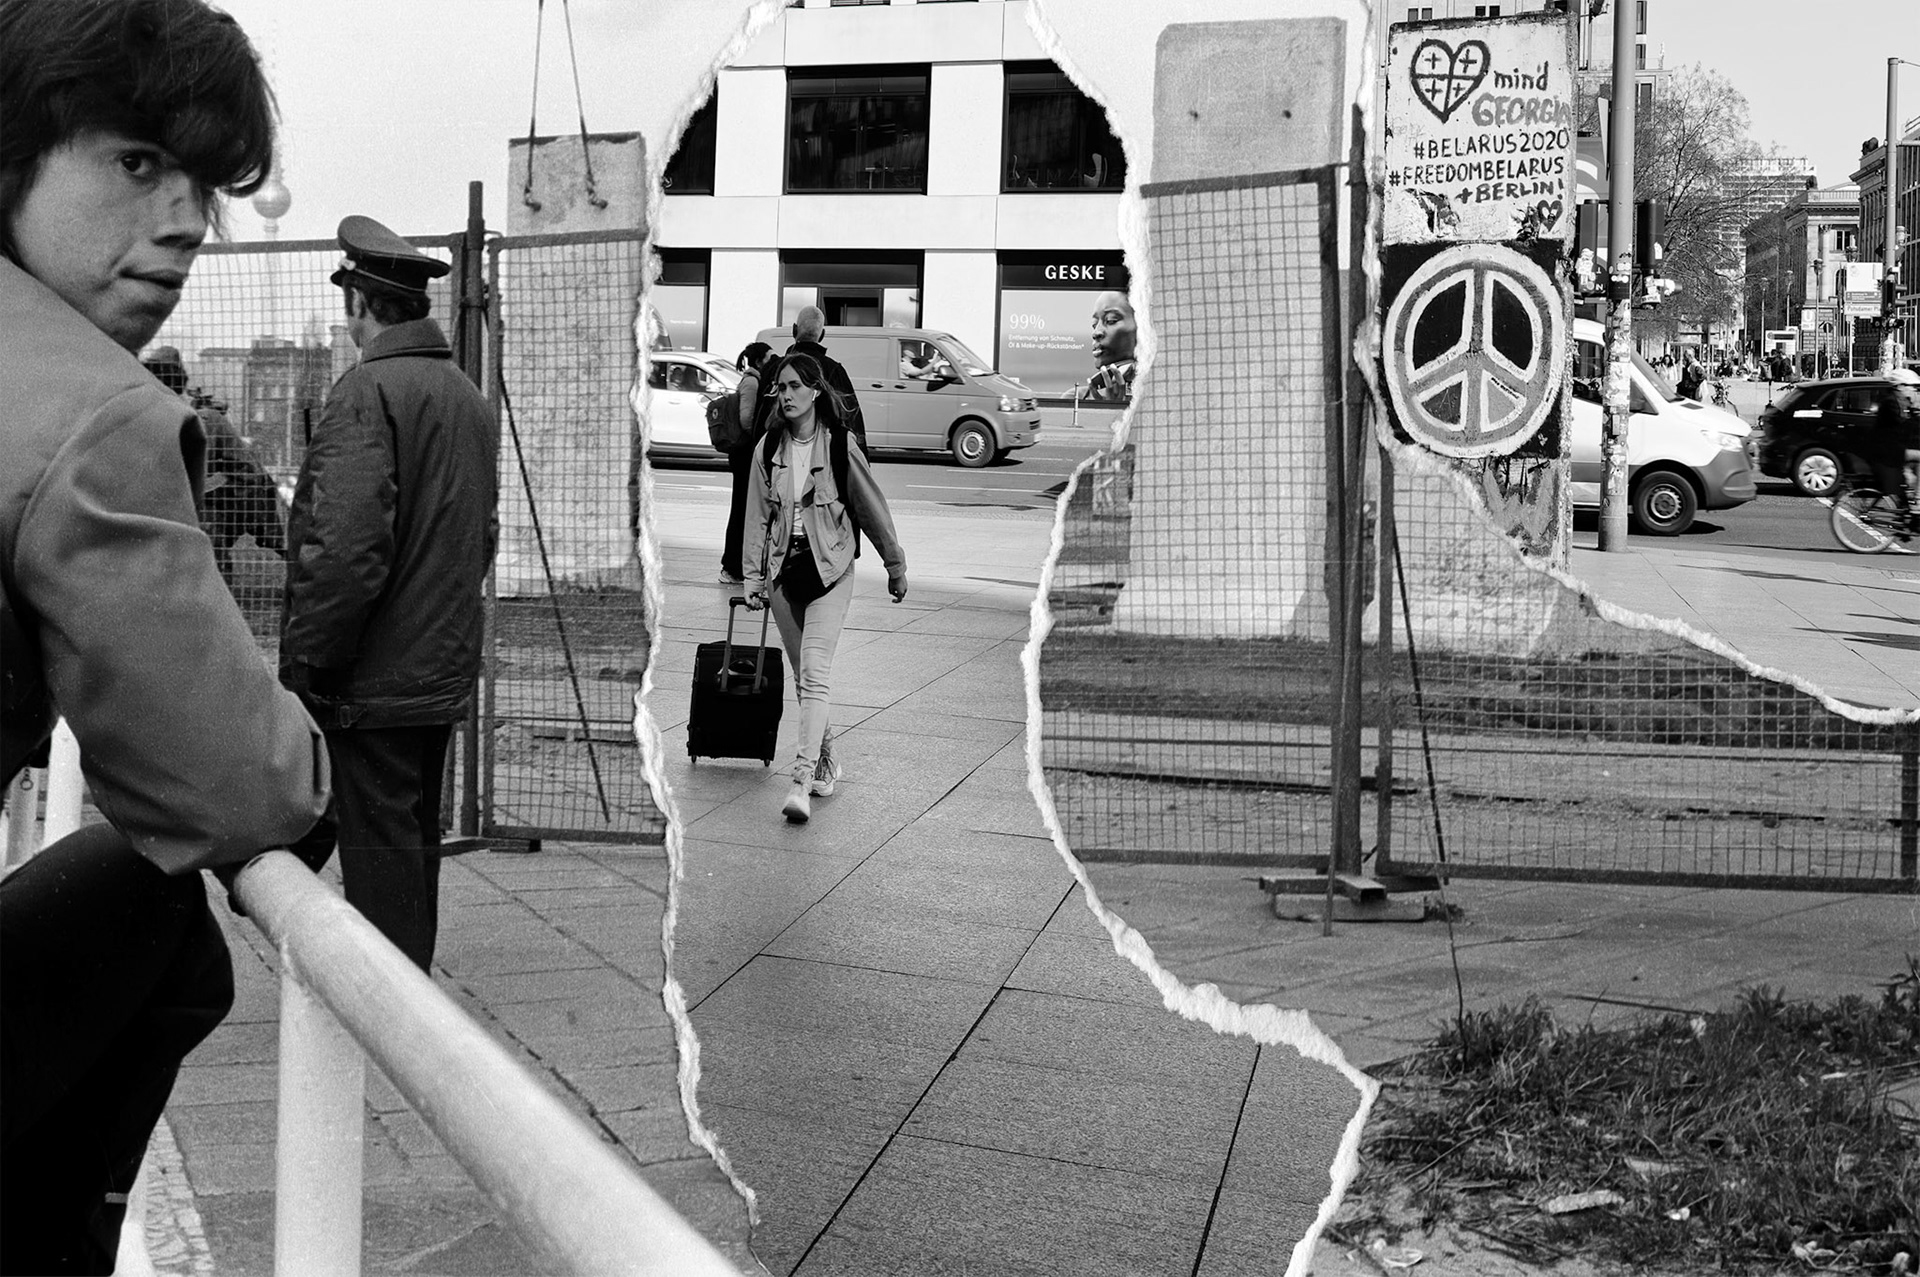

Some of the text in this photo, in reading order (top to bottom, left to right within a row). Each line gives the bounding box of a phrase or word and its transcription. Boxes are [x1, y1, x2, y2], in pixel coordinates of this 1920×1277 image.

[1494, 61, 1549, 91] mind
[1414, 128, 1570, 159] #BELARUS2020
[1389, 157, 1564, 187] #FREEDOMBELARUS
[1045, 265, 1105, 280] GESKE
[1009, 313, 1045, 330] 99%
